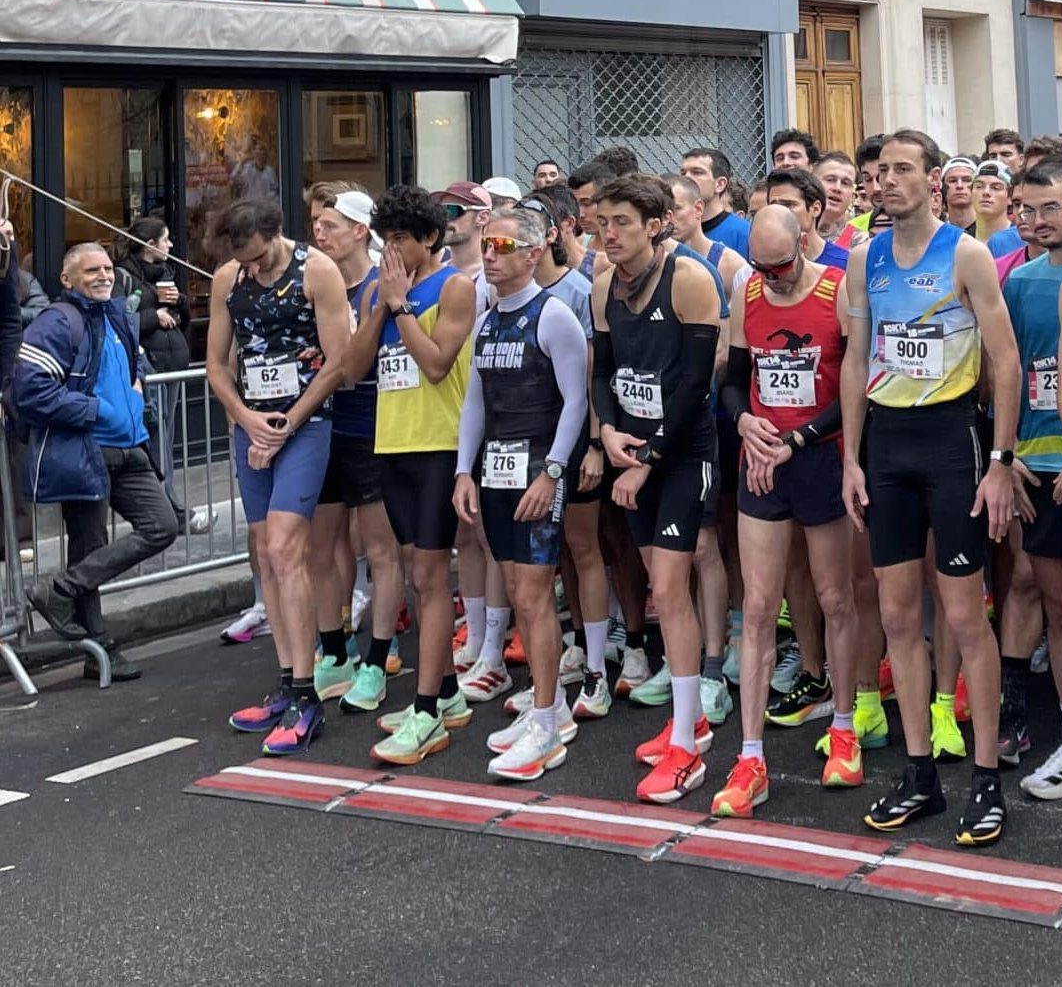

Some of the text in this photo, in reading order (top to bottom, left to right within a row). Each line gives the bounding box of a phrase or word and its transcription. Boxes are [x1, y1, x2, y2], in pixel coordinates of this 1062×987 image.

[896, 340, 928, 358] 900
[380, 357, 408, 375] 2431
[261, 368, 280, 382] 62
[769, 372, 800, 389] 243
[1044, 374, 1058, 389] 23
[622, 382, 654, 402] 2440
[493, 455, 516, 471] 276
